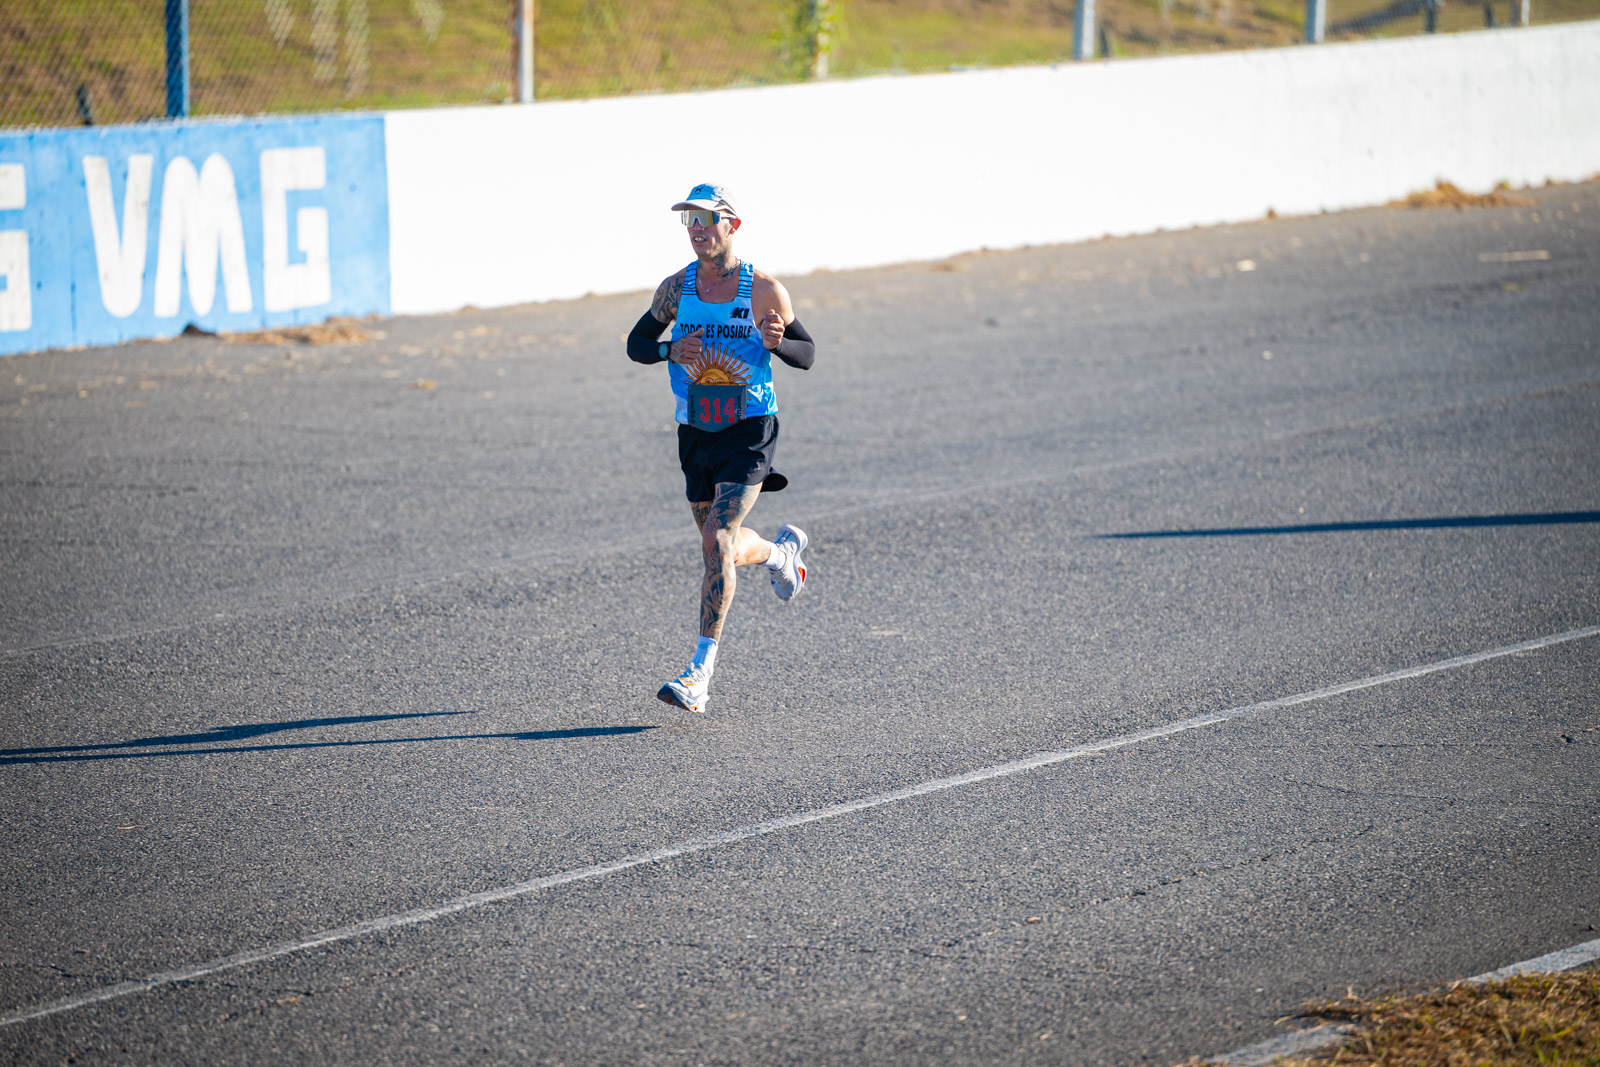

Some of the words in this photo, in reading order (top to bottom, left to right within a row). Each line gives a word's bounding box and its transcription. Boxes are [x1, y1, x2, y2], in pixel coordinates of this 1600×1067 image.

[83, 146, 331, 318] VMG
[706, 324, 715, 338] ES
[717, 325, 752, 339] POSIBLE
[700, 397, 736, 423] 314
